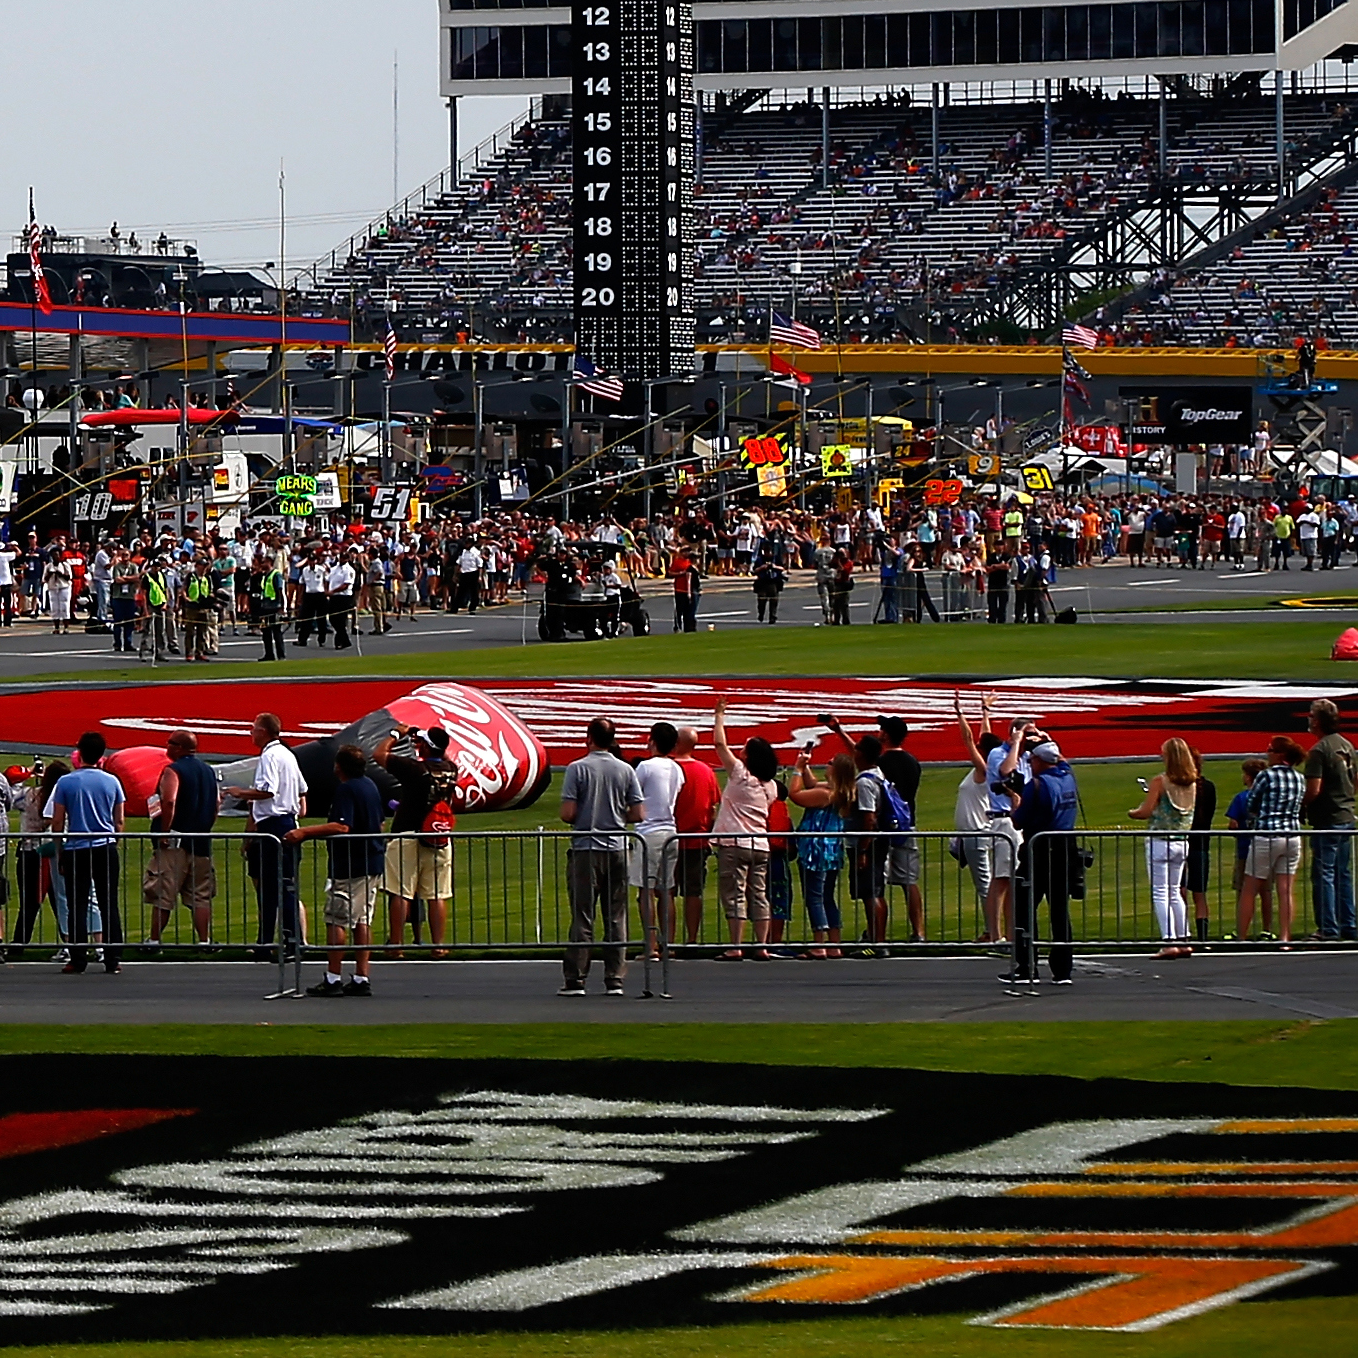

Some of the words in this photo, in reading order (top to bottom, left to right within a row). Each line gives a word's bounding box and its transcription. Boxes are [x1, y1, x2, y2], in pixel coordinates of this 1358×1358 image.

[582, 7, 611, 25] 12
[665, 6, 676, 26] 12
[582, 43, 611, 61] 13
[665, 42, 676, 62] 13
[582, 78, 611, 95] 14
[665, 77, 676, 96] 14
[582, 113, 611, 131] 15
[665, 112, 676, 132] 15
[582, 147, 611, 165] 16
[665, 146, 676, 166] 16
[582, 183, 611, 201] 17
[665, 182, 676, 202] 17
[582, 217, 611, 236] 18
[665, 216, 676, 237] 18
[582, 253, 611, 271] 19
[665, 252, 676, 272] 19
[581, 288, 615, 306] 20
[666, 287, 678, 307] 20
[1180, 408, 1243, 423] TopGear
[744, 437, 785, 465] 88
[894, 444, 911, 458] 24
[976, 455, 994, 475] 9
[278, 476, 316, 493] MEARS
[1023, 467, 1054, 490] 31
[924, 479, 964, 505] 22
[74, 493, 112, 521] 10
[280, 501, 313, 516] GANG
[370, 487, 411, 520] 51
